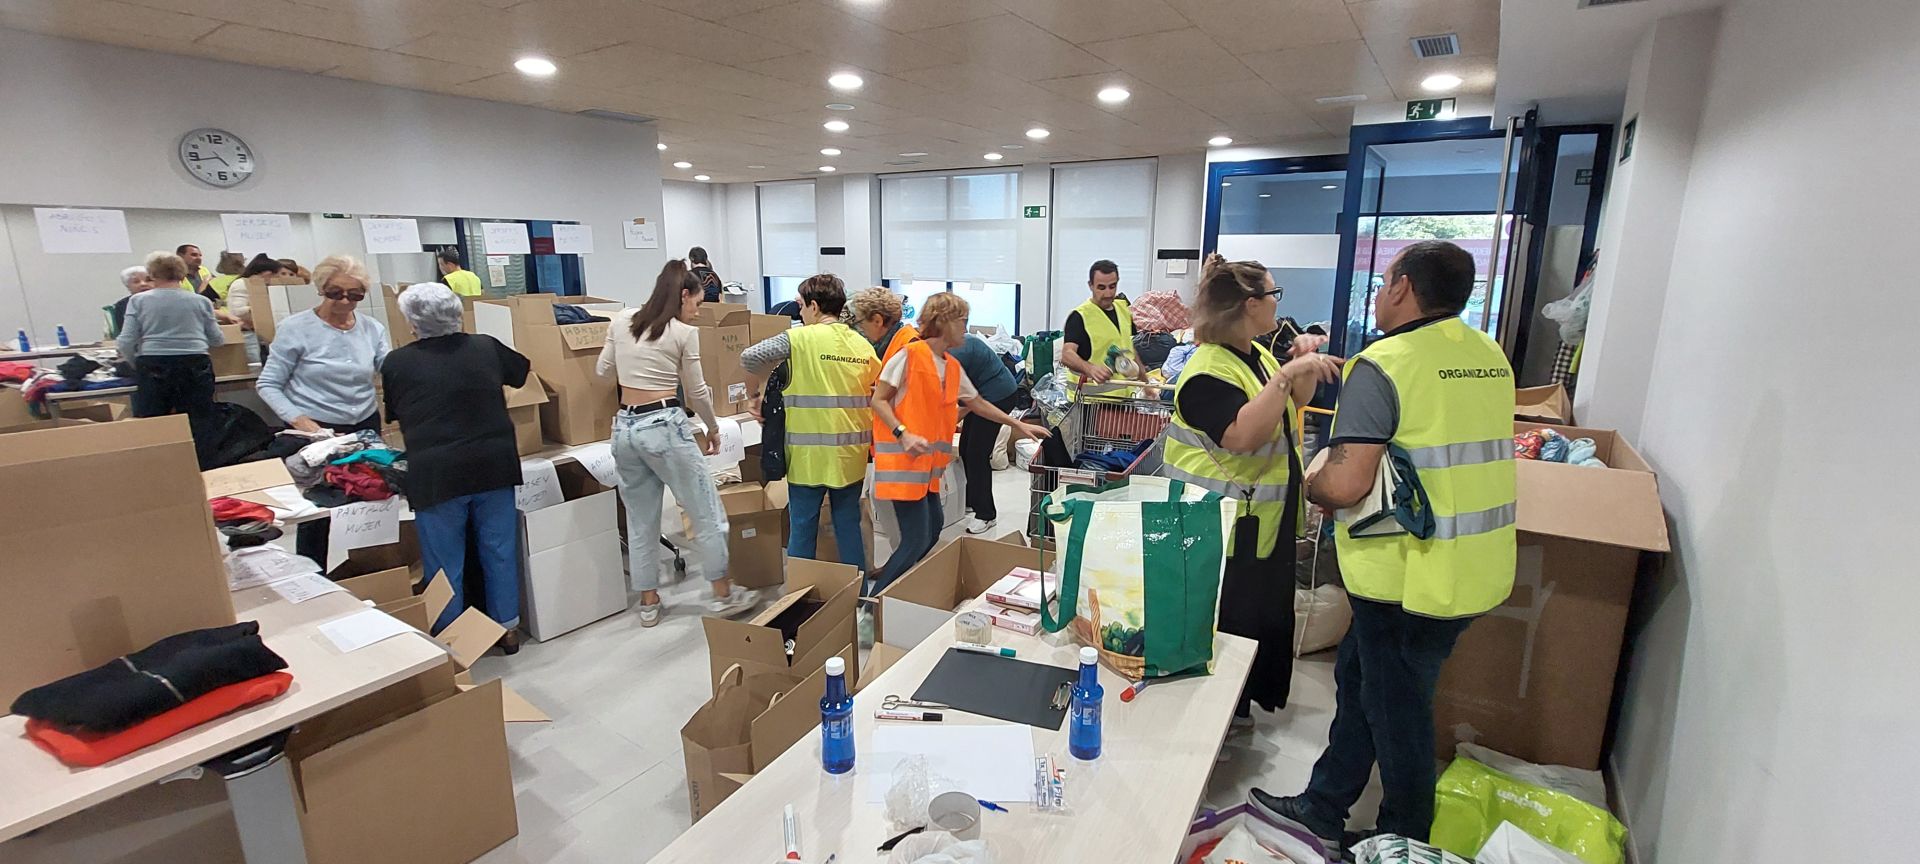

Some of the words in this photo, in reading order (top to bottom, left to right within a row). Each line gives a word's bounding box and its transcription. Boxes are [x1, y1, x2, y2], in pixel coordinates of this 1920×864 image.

[206, 134, 223, 145] 12
[188, 151, 200, 162] 9
[236, 153, 248, 163] 3
[217, 171, 229, 181] 6
[745, 634, 753, 644] 4
